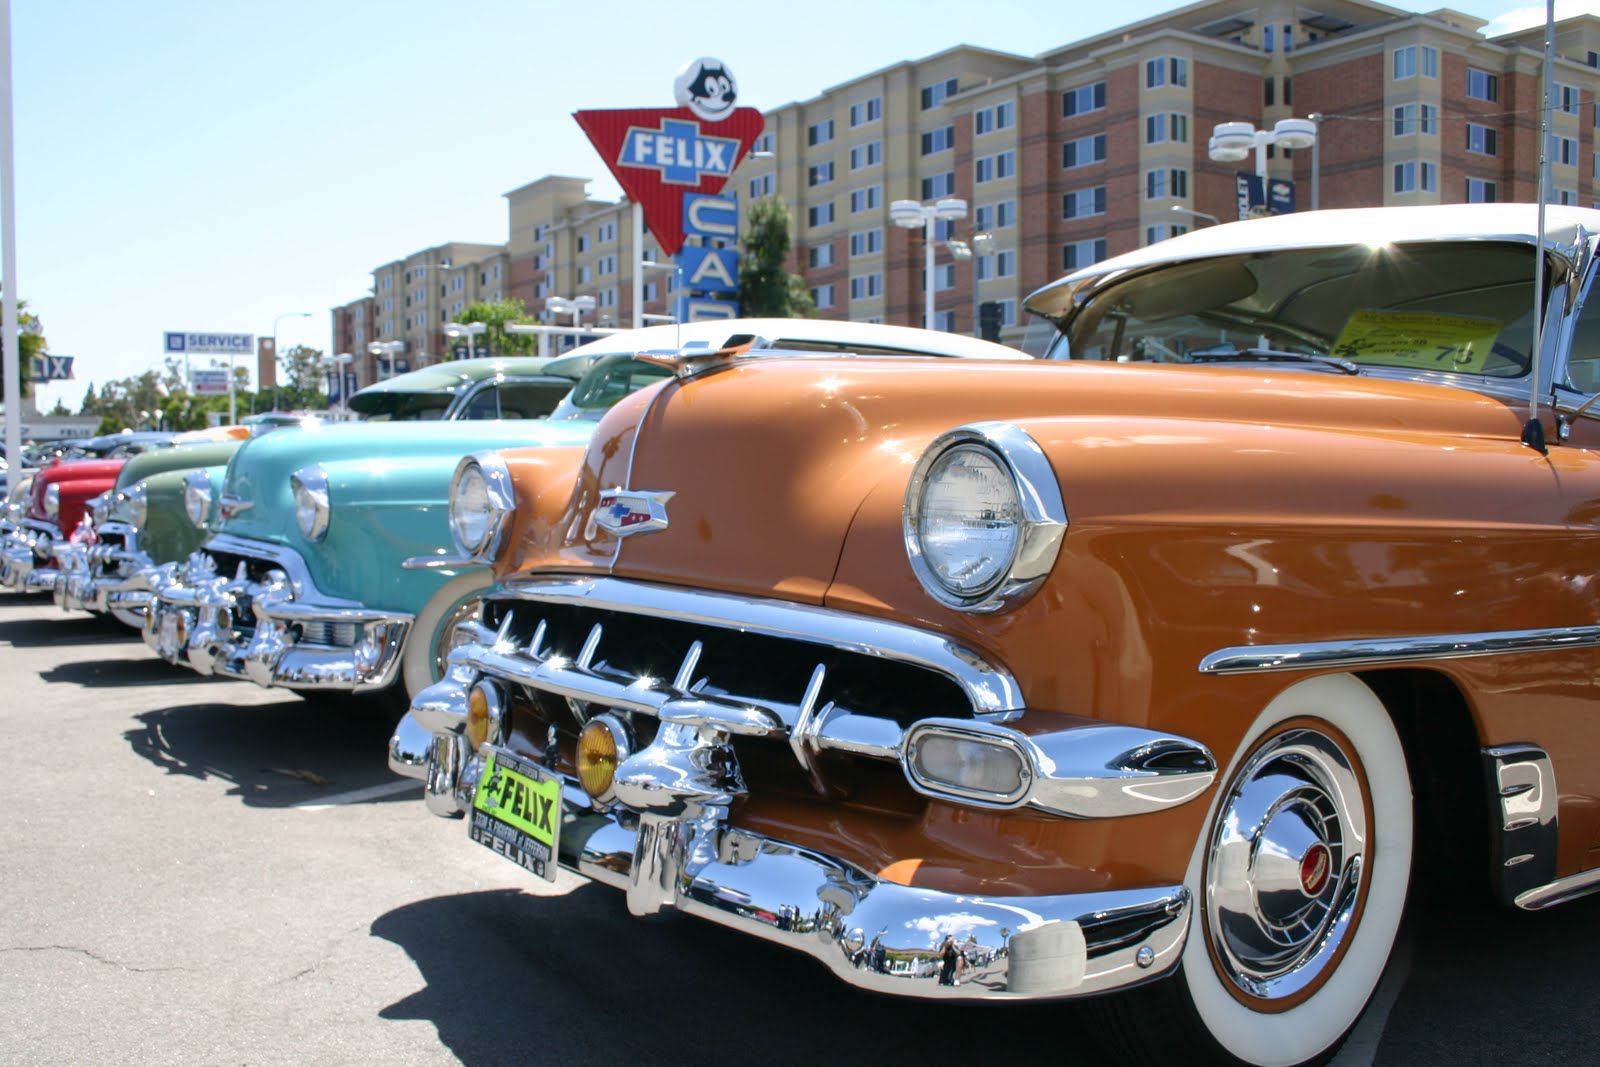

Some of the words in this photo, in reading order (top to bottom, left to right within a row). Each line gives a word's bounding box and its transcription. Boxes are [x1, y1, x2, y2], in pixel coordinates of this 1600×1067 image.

[634, 132, 726, 172] FELIX
[1236, 176, 1250, 221] ROLET
[189, 335, 251, 347] SERVICE
[29, 355, 67, 378] LIX
[499, 775, 554, 836] FELIX
[481, 831, 535, 872] FELIX
[524, 836, 551, 863] JEFFERSON
